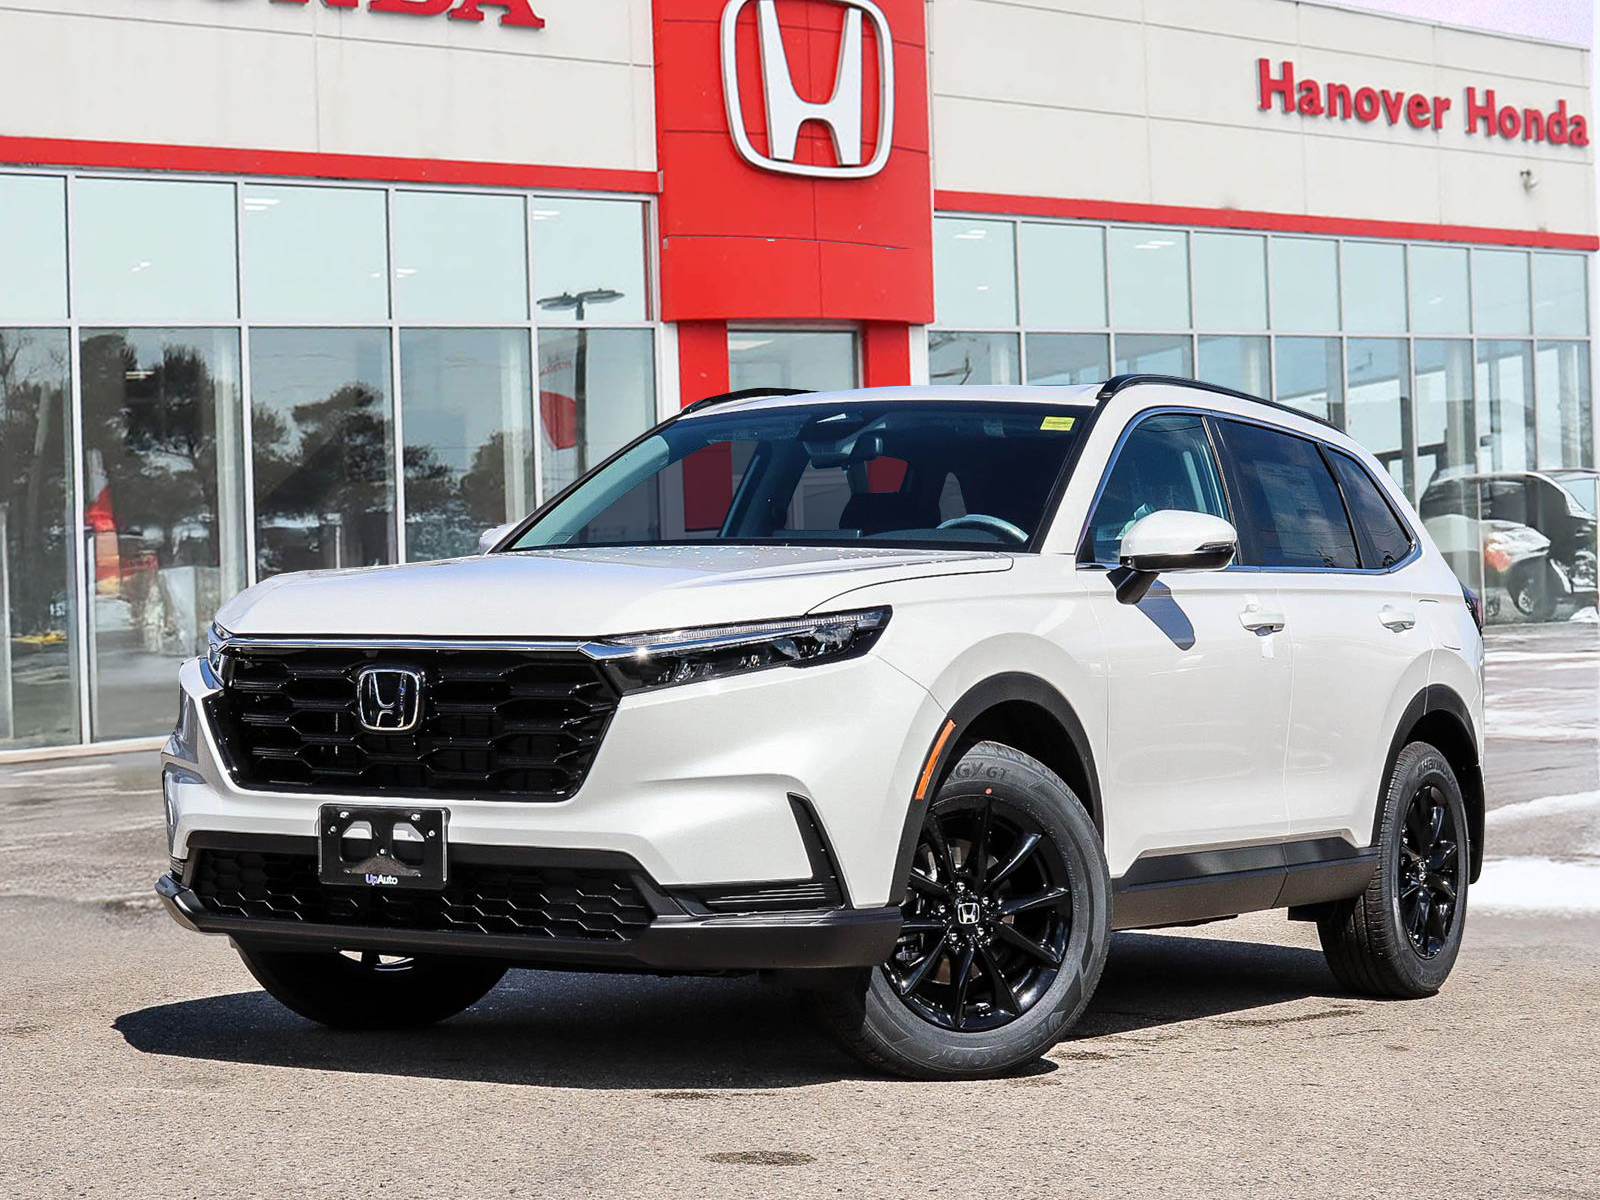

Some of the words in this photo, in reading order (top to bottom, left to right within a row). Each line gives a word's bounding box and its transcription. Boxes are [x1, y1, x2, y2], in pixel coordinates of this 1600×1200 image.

[1257, 57, 1452, 130] Hanover
[1464, 85, 1590, 147] Honda
[365, 873, 399, 886] UpAuto
